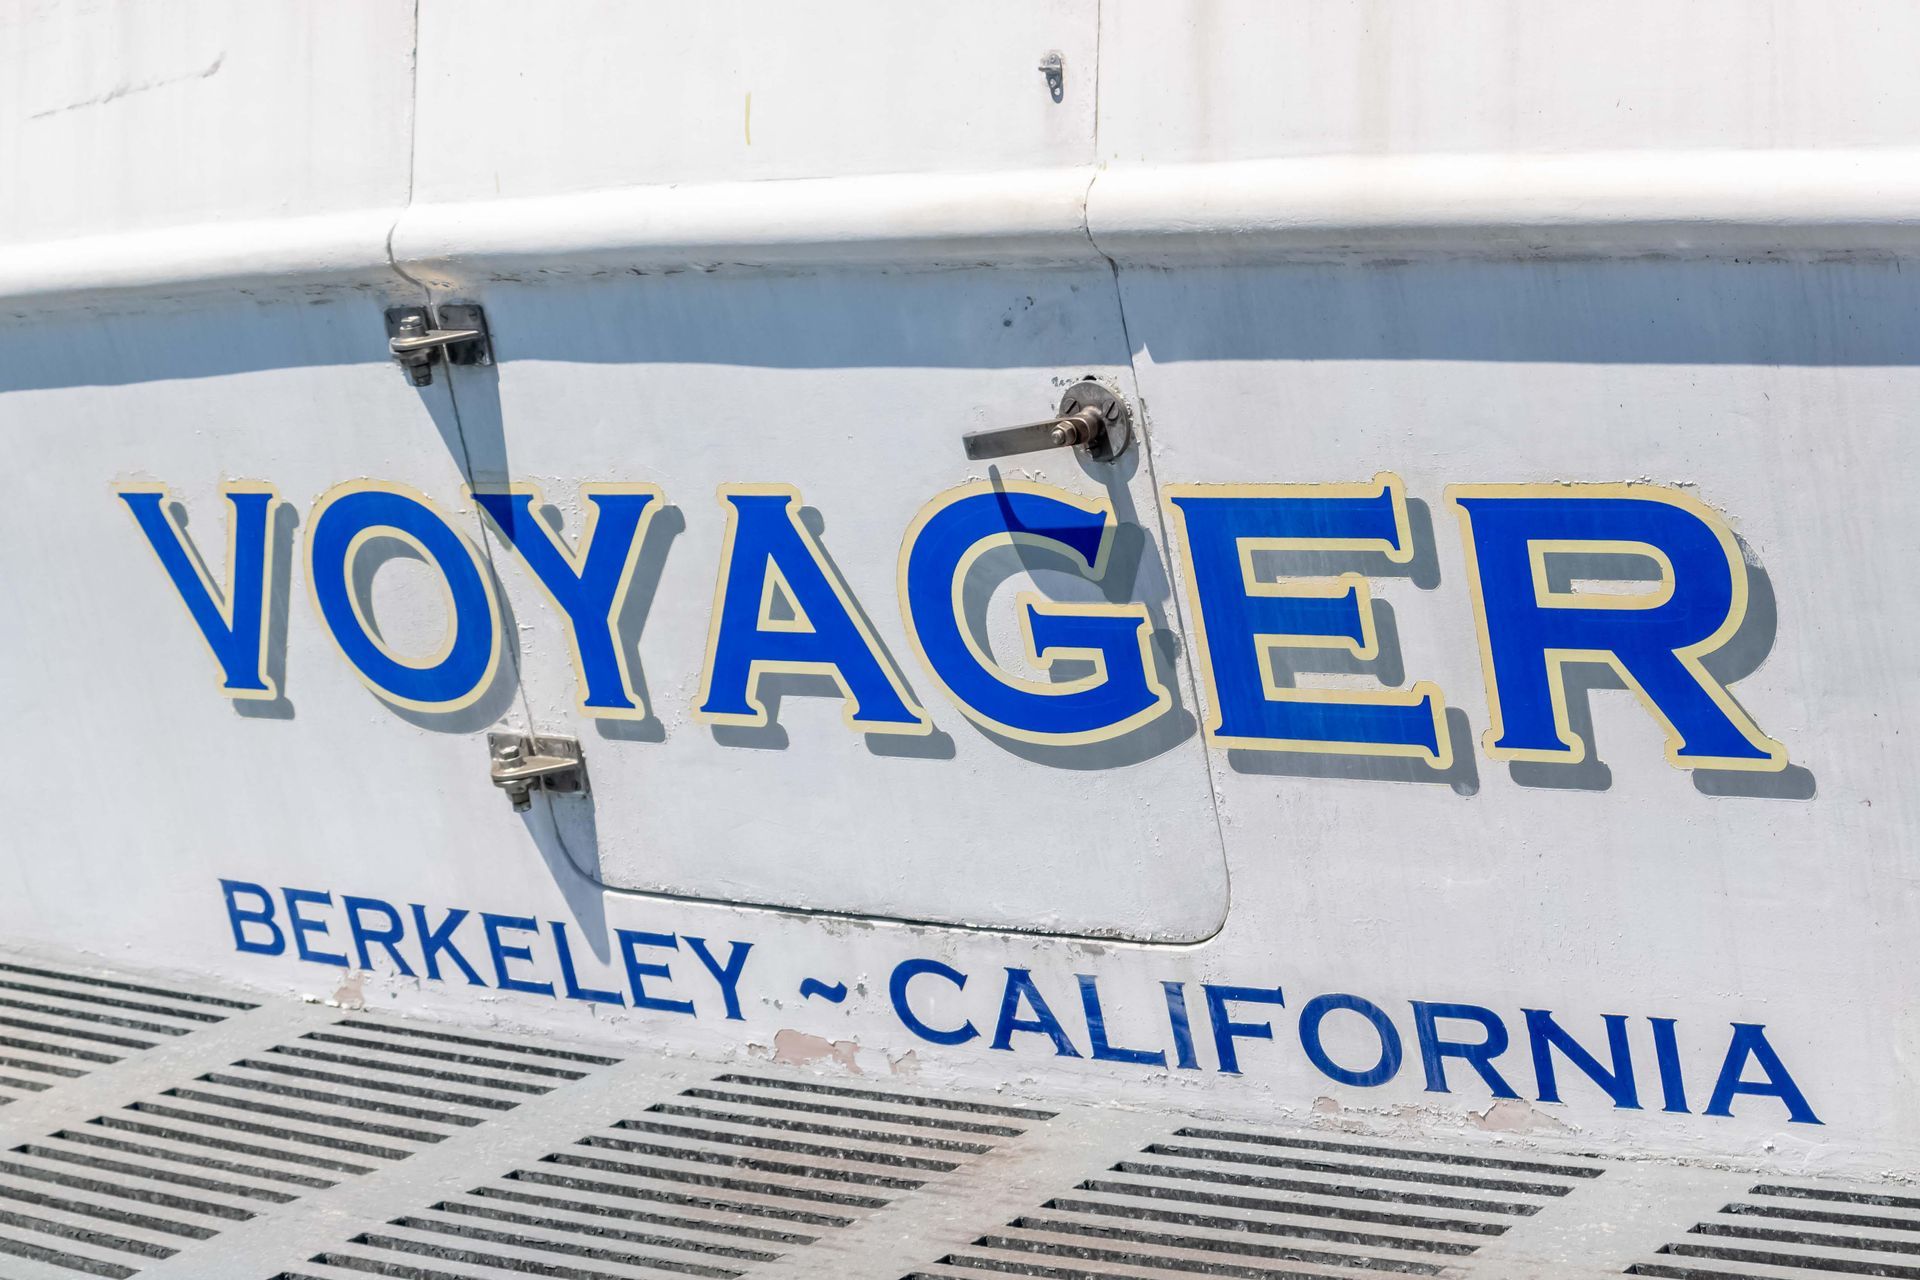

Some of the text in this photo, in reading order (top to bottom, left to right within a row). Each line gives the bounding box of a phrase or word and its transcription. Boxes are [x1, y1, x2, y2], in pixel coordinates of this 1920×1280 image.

[116, 474, 1792, 774] VOYAGER
[221, 880, 753, 1021] BERKELEY
[889, 958, 1824, 1126] CALIFORNIA
